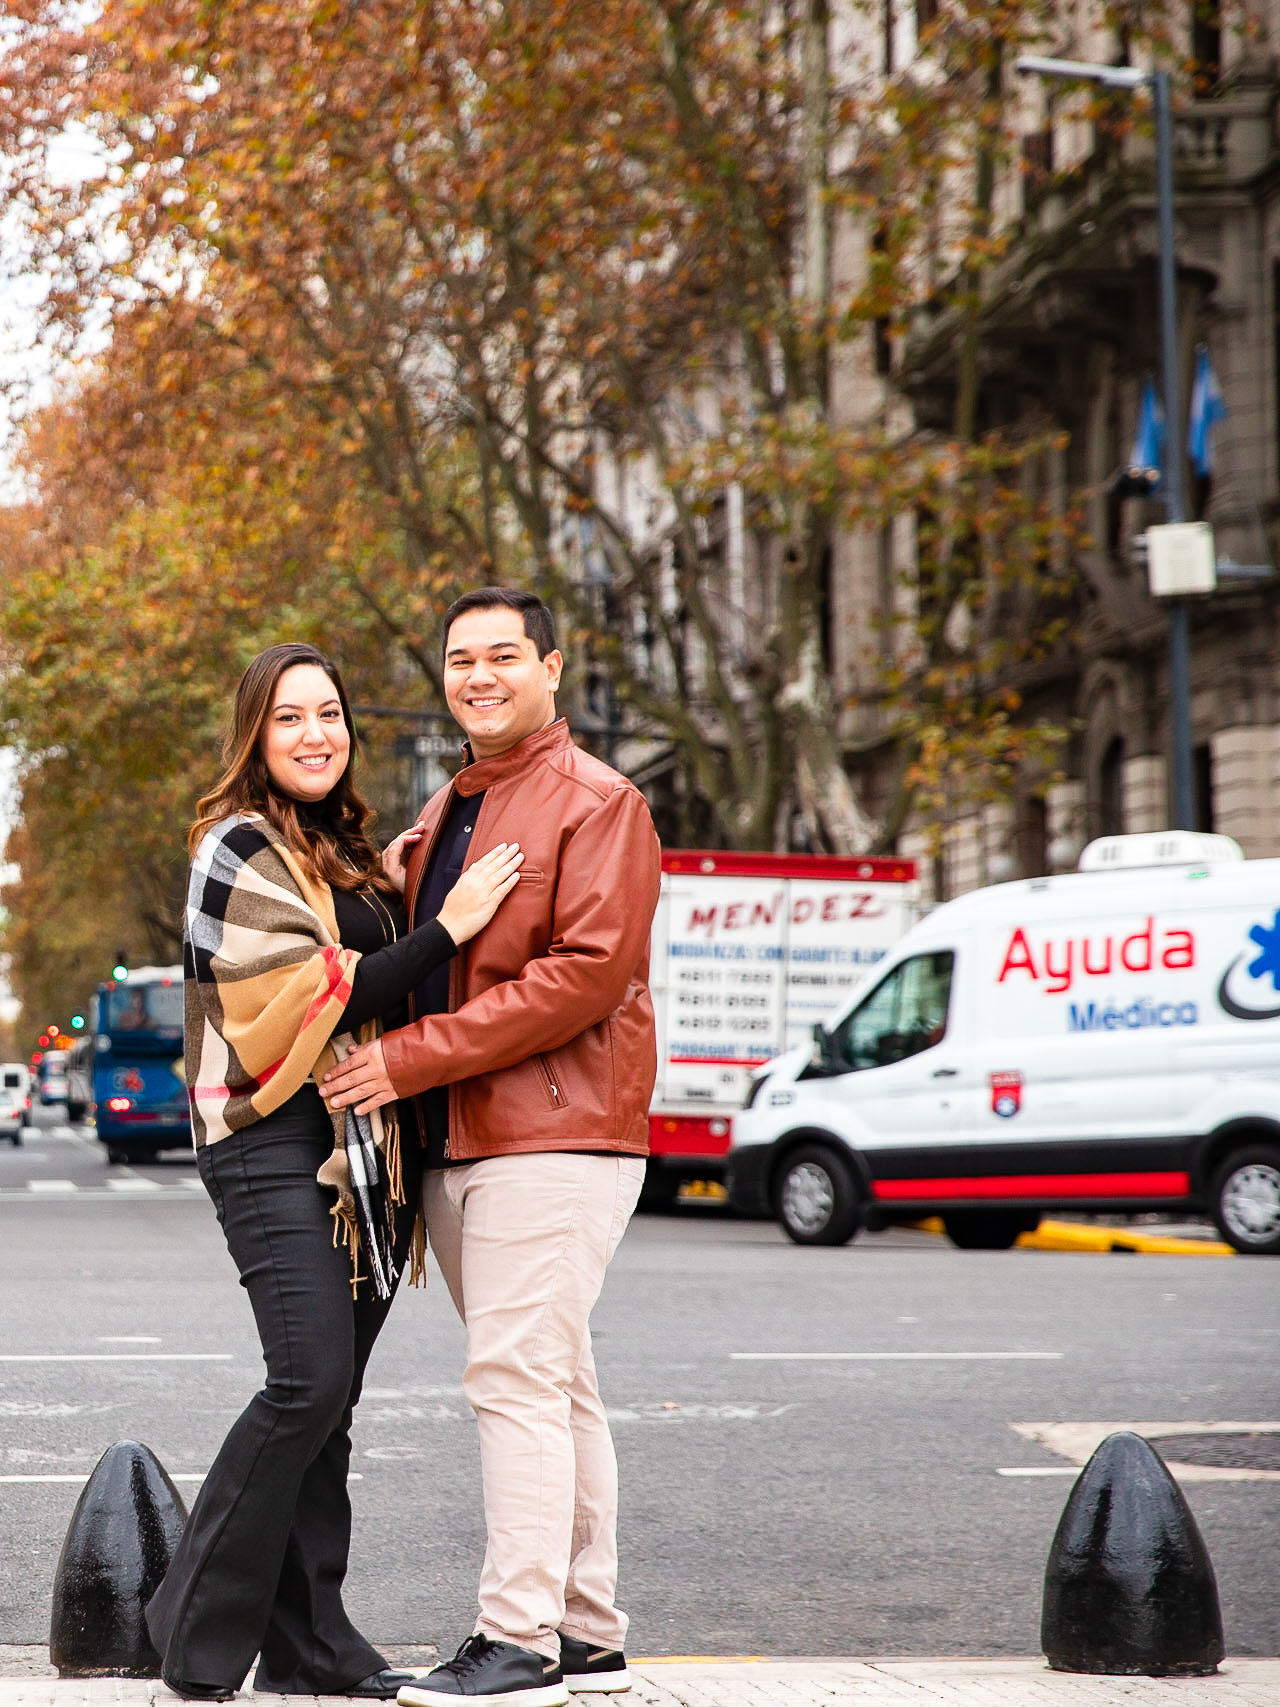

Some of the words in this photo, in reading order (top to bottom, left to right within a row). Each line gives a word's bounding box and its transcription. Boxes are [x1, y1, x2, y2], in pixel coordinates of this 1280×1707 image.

[686, 892, 887, 938] MENDEZ
[997, 915, 1195, 993] Ayuda
[1068, 994, 1198, 1031] Médica
